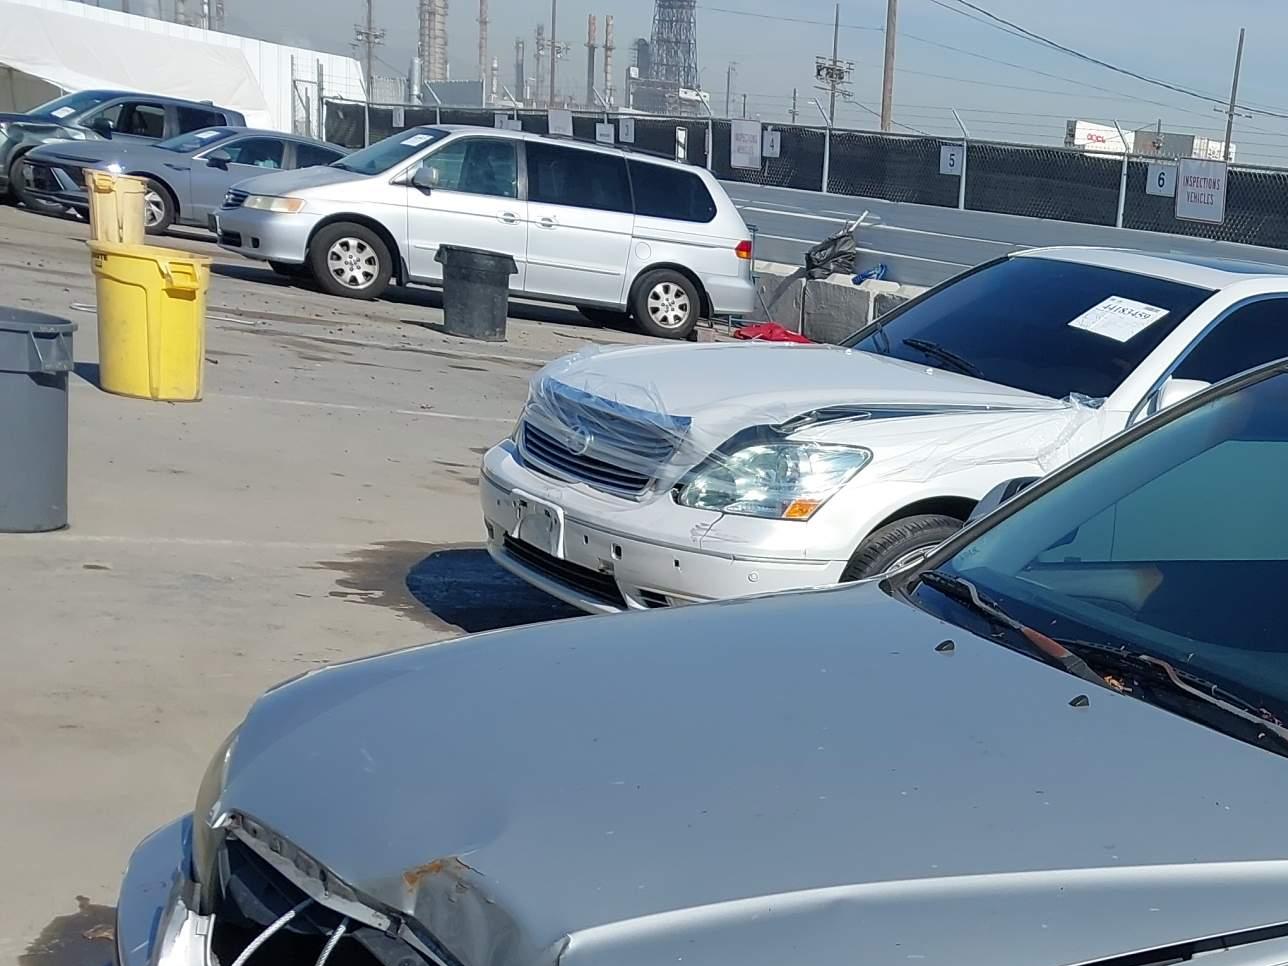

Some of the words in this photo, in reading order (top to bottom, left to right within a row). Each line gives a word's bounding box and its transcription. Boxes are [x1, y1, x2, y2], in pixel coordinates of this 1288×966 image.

[949, 153, 955, 167] 5
[1158, 171, 1165, 188] 6
[1183, 175, 1221, 190] INSPECTIONS
[1187, 191, 1214, 205] VEHICLES
